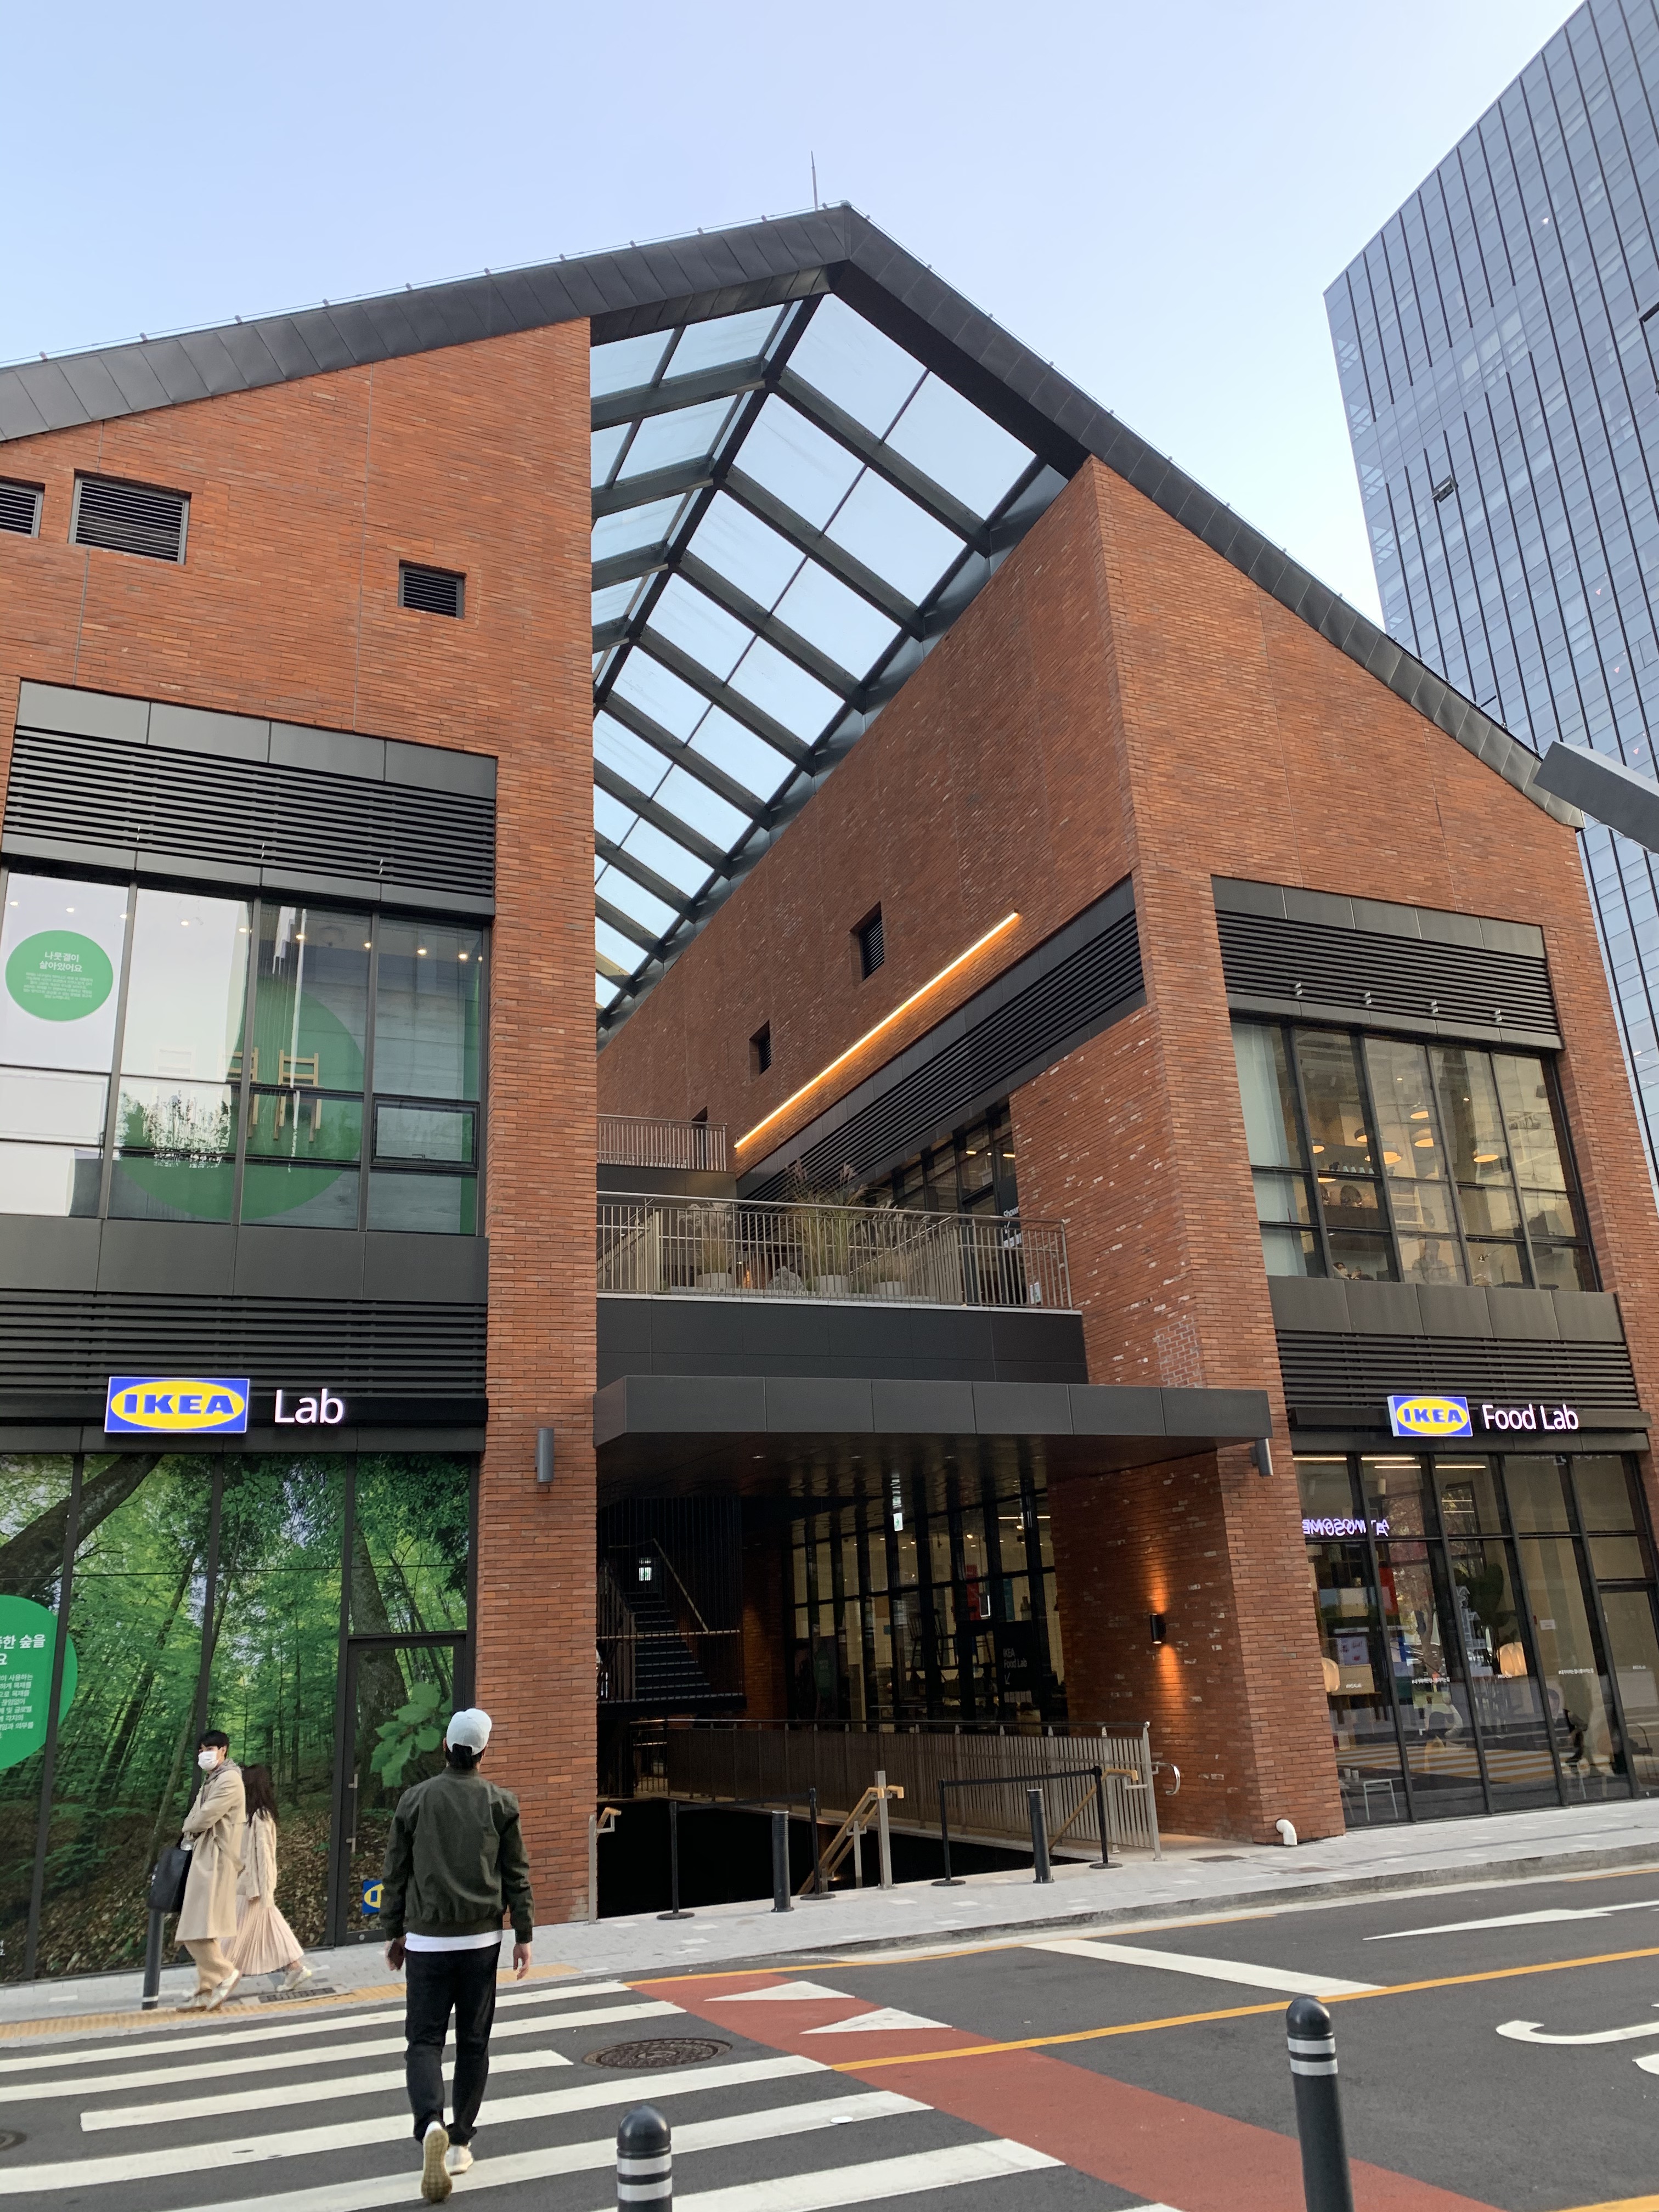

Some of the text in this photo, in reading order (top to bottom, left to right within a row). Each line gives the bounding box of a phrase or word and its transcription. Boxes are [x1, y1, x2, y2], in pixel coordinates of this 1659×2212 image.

[44, 951, 79, 962] 나뭇결이
[39, 961, 82, 972] 살아있어요
[123, 1388, 344, 1424] IKEA Lab
[1403, 1404, 1579, 1430] IKEA Food Lab
[0, 1634, 46, 1650] 한 숲을
[8, 1673, 33, 1681] 사용하는
